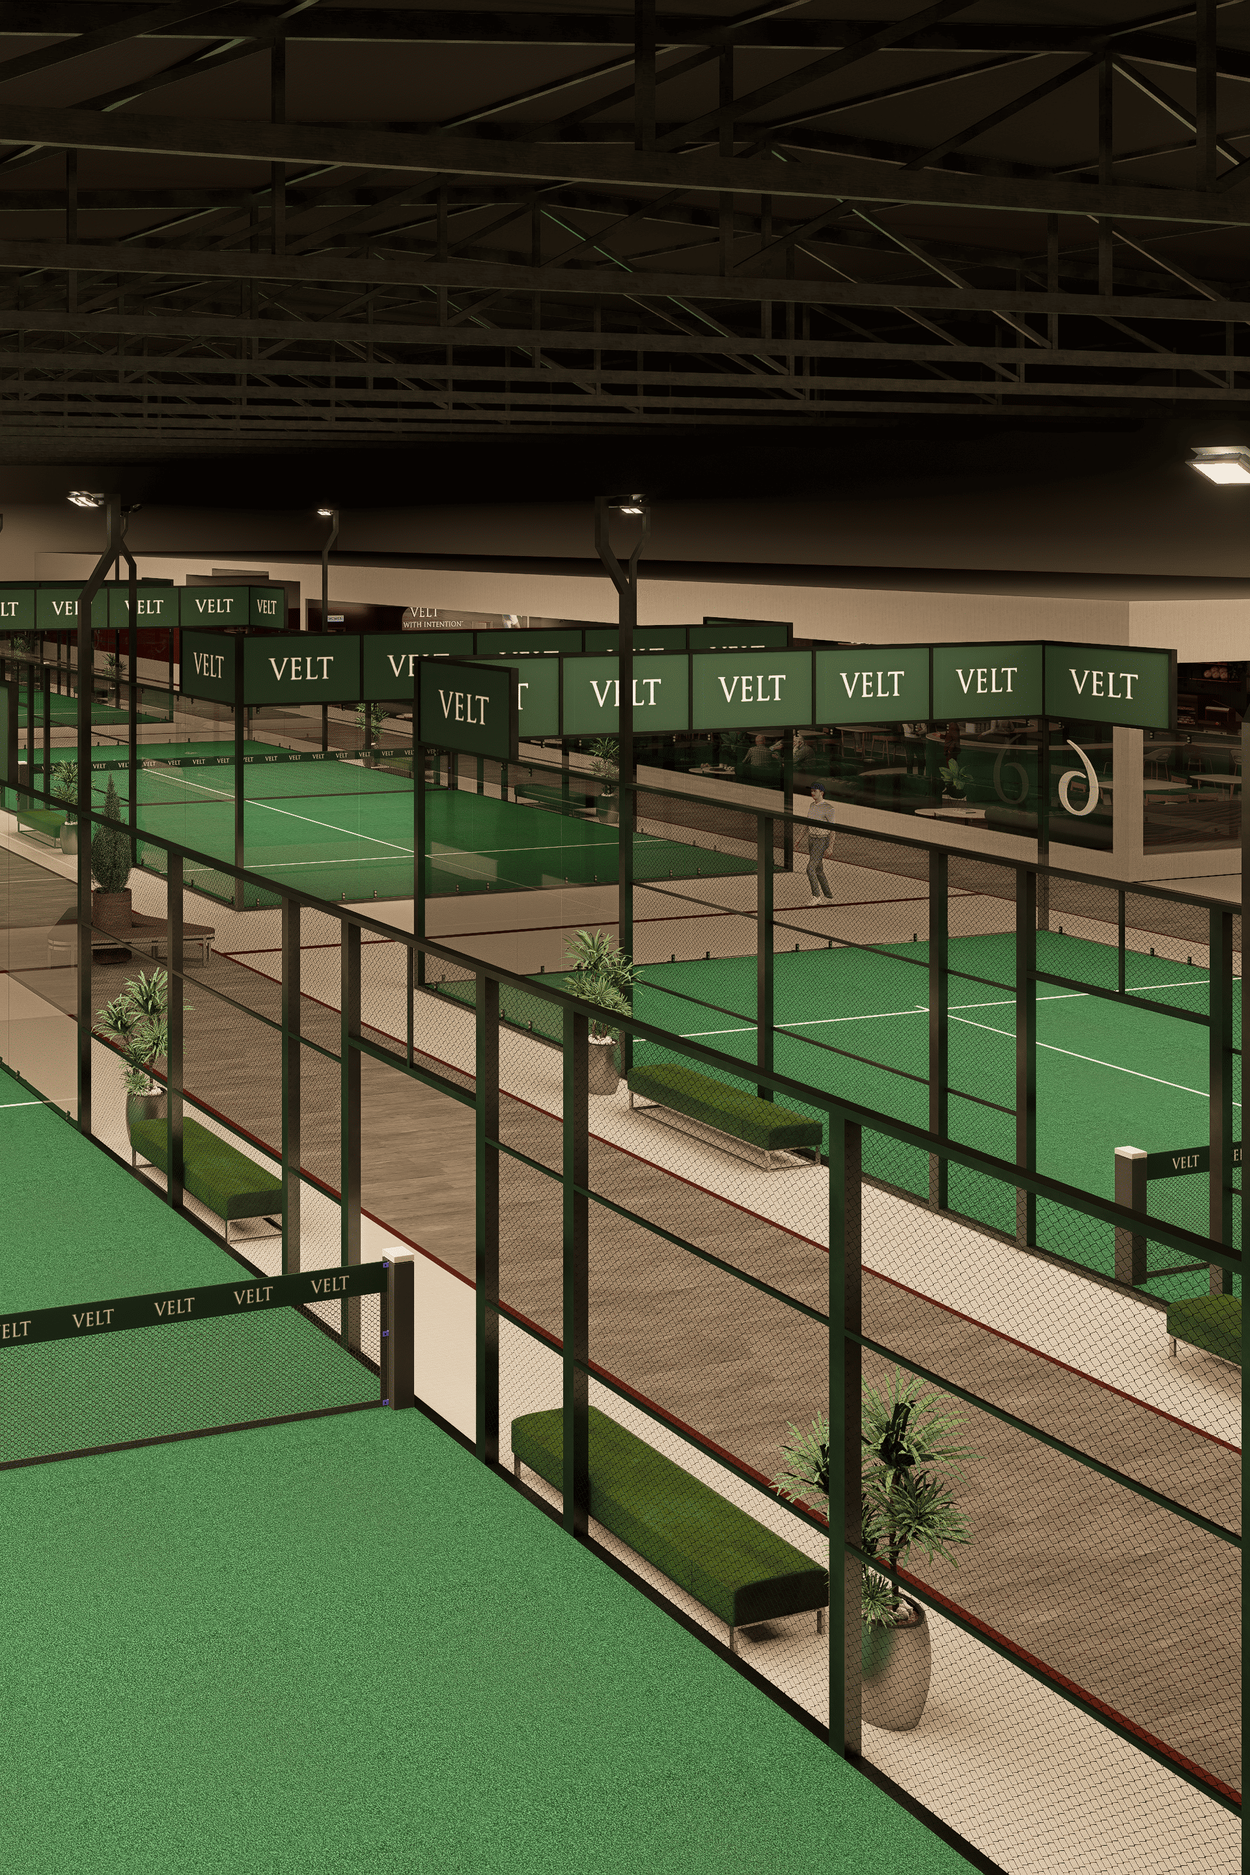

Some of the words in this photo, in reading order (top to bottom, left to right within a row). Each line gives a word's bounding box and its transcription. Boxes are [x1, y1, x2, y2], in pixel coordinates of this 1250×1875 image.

[52, 601, 80, 616] VEL
[196, 599, 233, 612] VELT
[257, 600, 276, 614] VELT
[403, 621, 422, 629] WITH
[424, 620, 462, 629] INTENTION
[194, 652, 224, 678] VELT
[269, 657, 333, 680] VELT
[718, 675, 786, 702] VELT
[840, 671, 904, 698] VELT
[956, 668, 1017, 693] VELT
[1069, 669, 1138, 699] VELT
[439, 690, 489, 725] VELT
[1173, 1155, 1199, 1169] VELT
[73, 1309, 114, 1328] VELT
[155, 1298, 195, 1316] VELT
[234, 1287, 273, 1304] VELT
[311, 1275, 350, 1294] VELT
